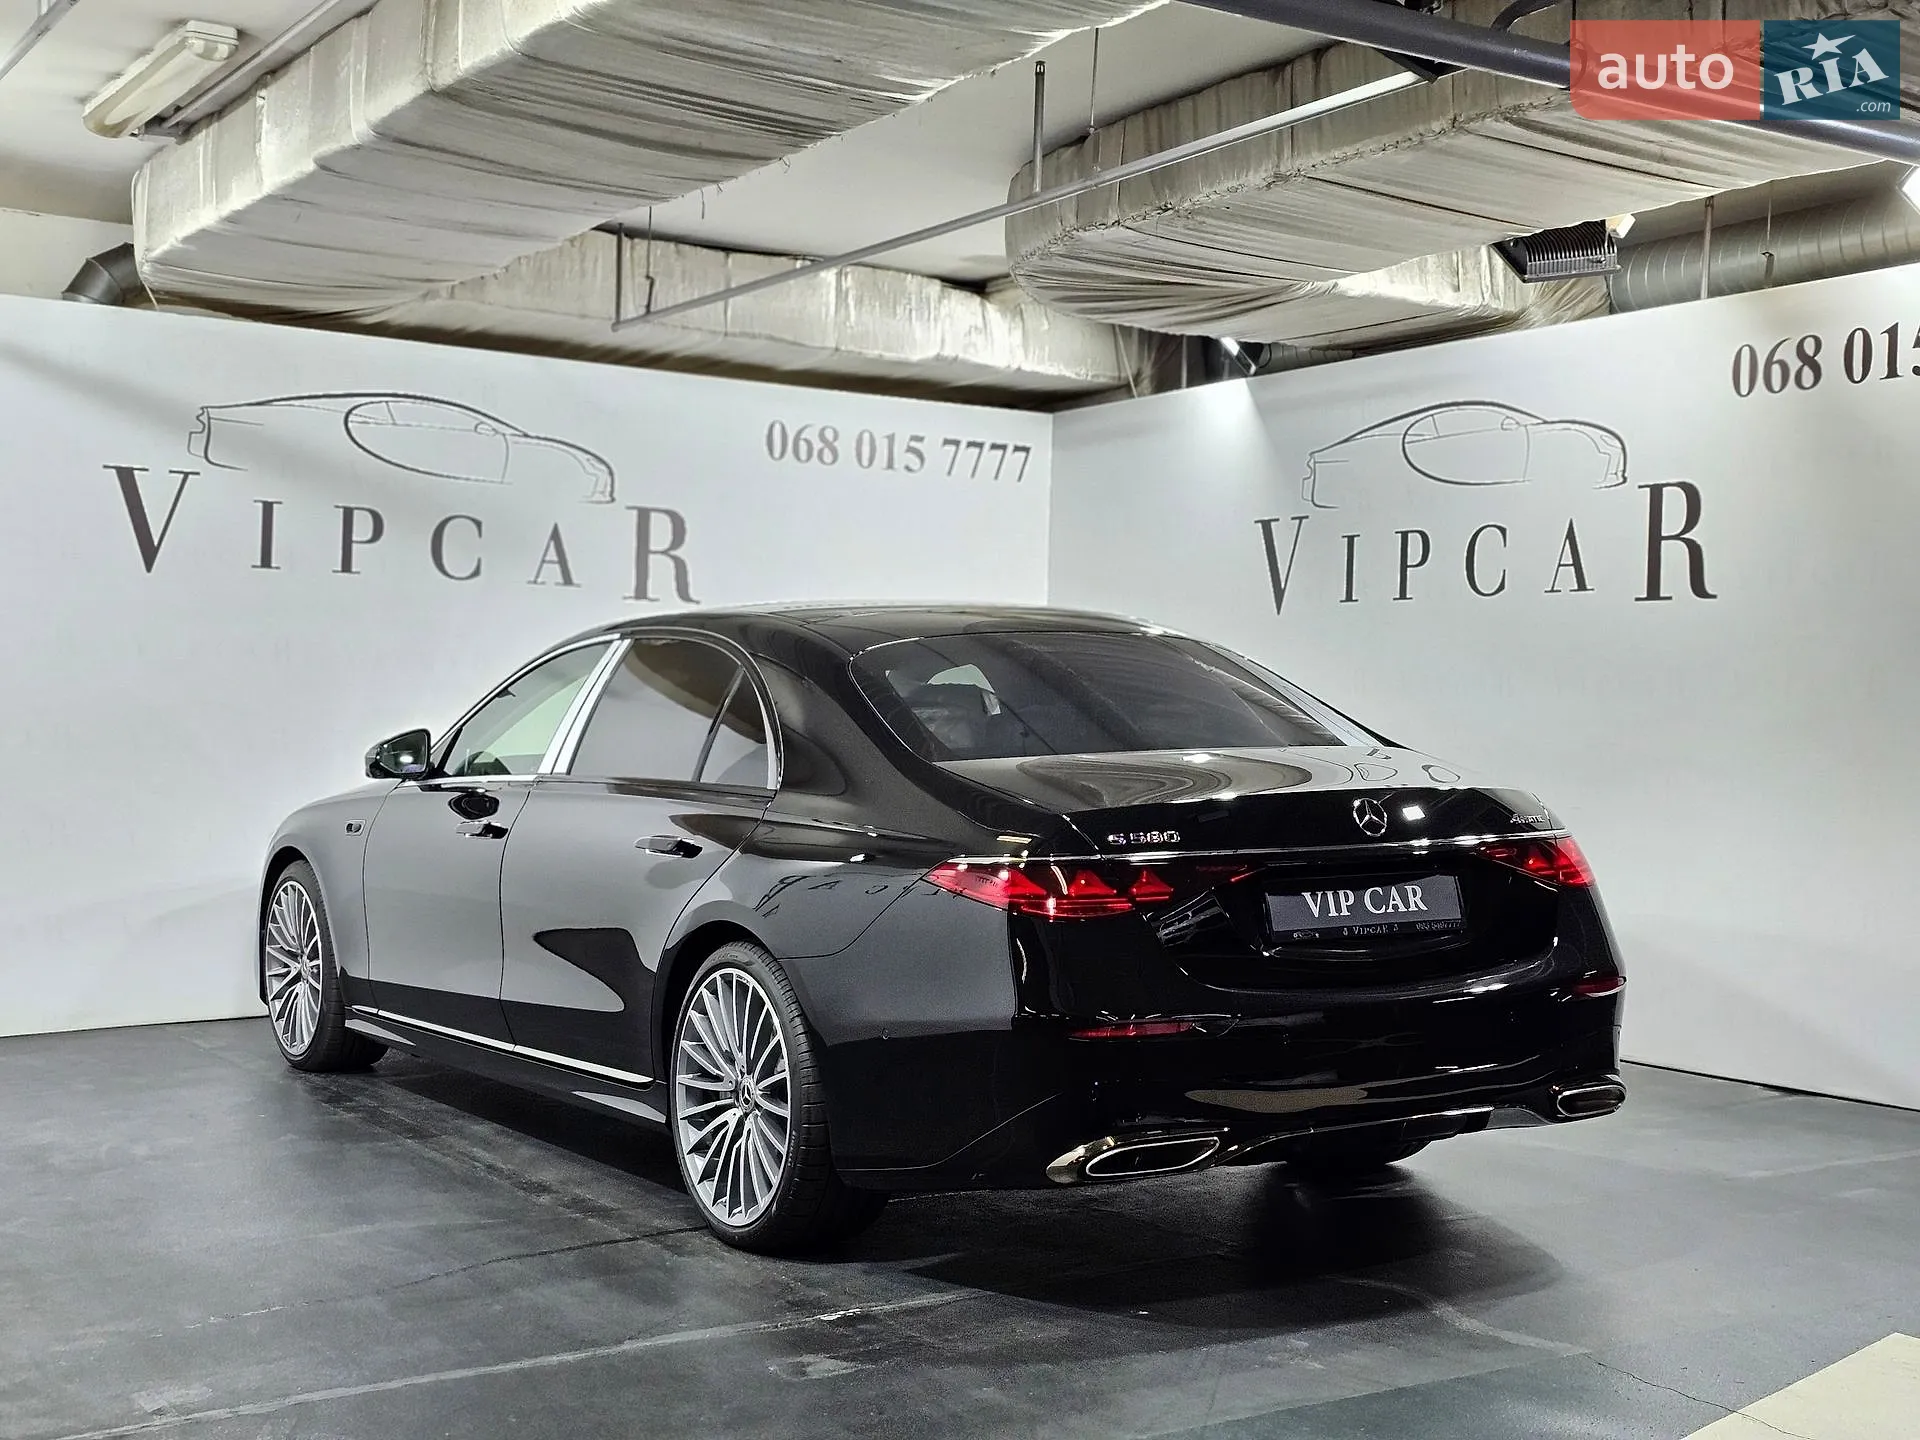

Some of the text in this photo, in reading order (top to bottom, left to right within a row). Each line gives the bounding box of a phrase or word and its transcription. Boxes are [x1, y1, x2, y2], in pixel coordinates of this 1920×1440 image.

[1732, 334, 1822, 398] 068
[766, 419, 1032, 482] 068 015 7777
[103, 465, 700, 604] VIPCAR
[1254, 480, 1718, 616] VIPCAR
[1301, 885, 1428, 918] VIP CAR
